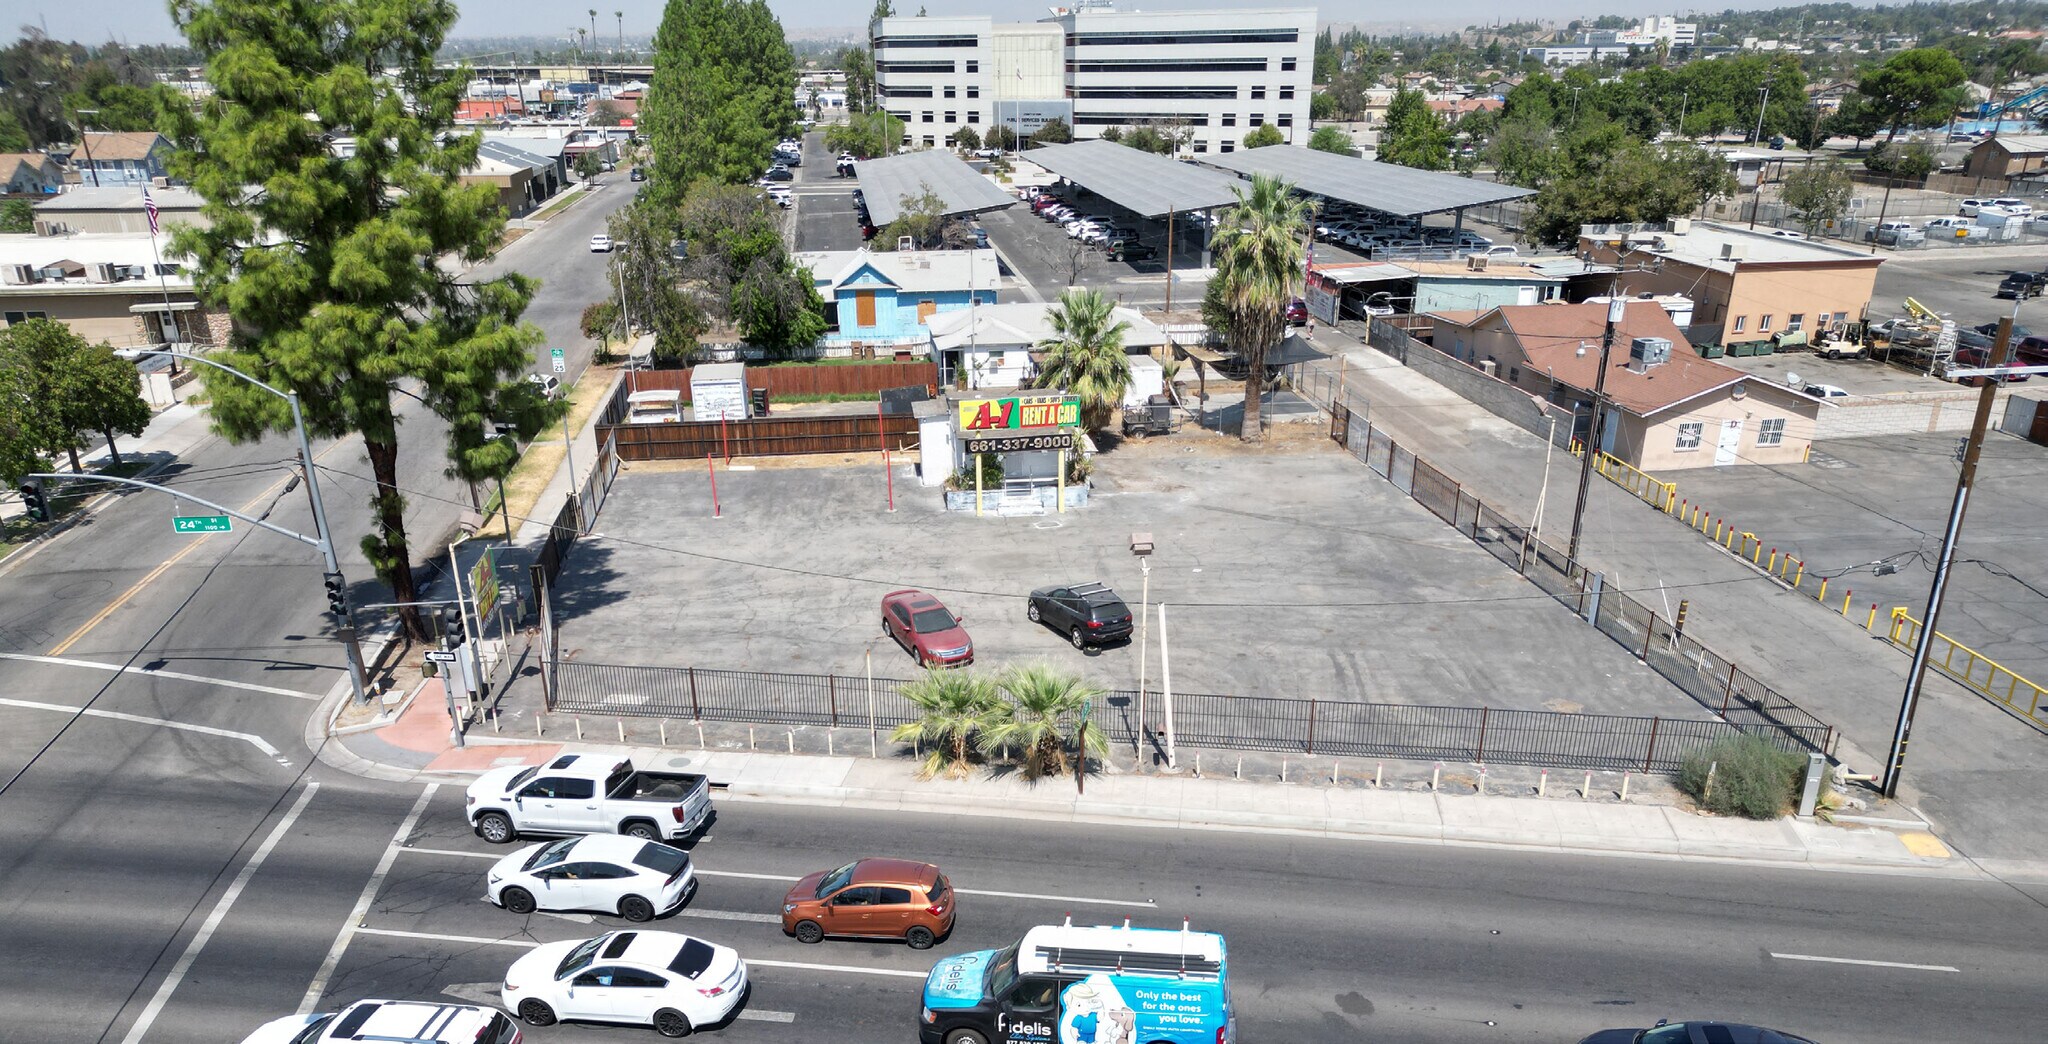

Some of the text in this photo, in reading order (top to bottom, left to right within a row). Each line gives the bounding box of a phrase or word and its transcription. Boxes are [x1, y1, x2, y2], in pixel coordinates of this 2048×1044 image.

[966, 401, 1013, 430] A-1
[1022, 404, 1077, 426] RENT A CAR
[970, 436, 1070, 452] 661-337-9000
[946, 956, 978, 990] fidelis
[1136, 990, 1201, 1001] Only the best
[1142, 1001, 1157, 1009] for
[1159, 1003, 1175, 1011] the
[998, 1012, 1051, 1035] fidelis
[1159, 1014, 1203, 1024] you love.
